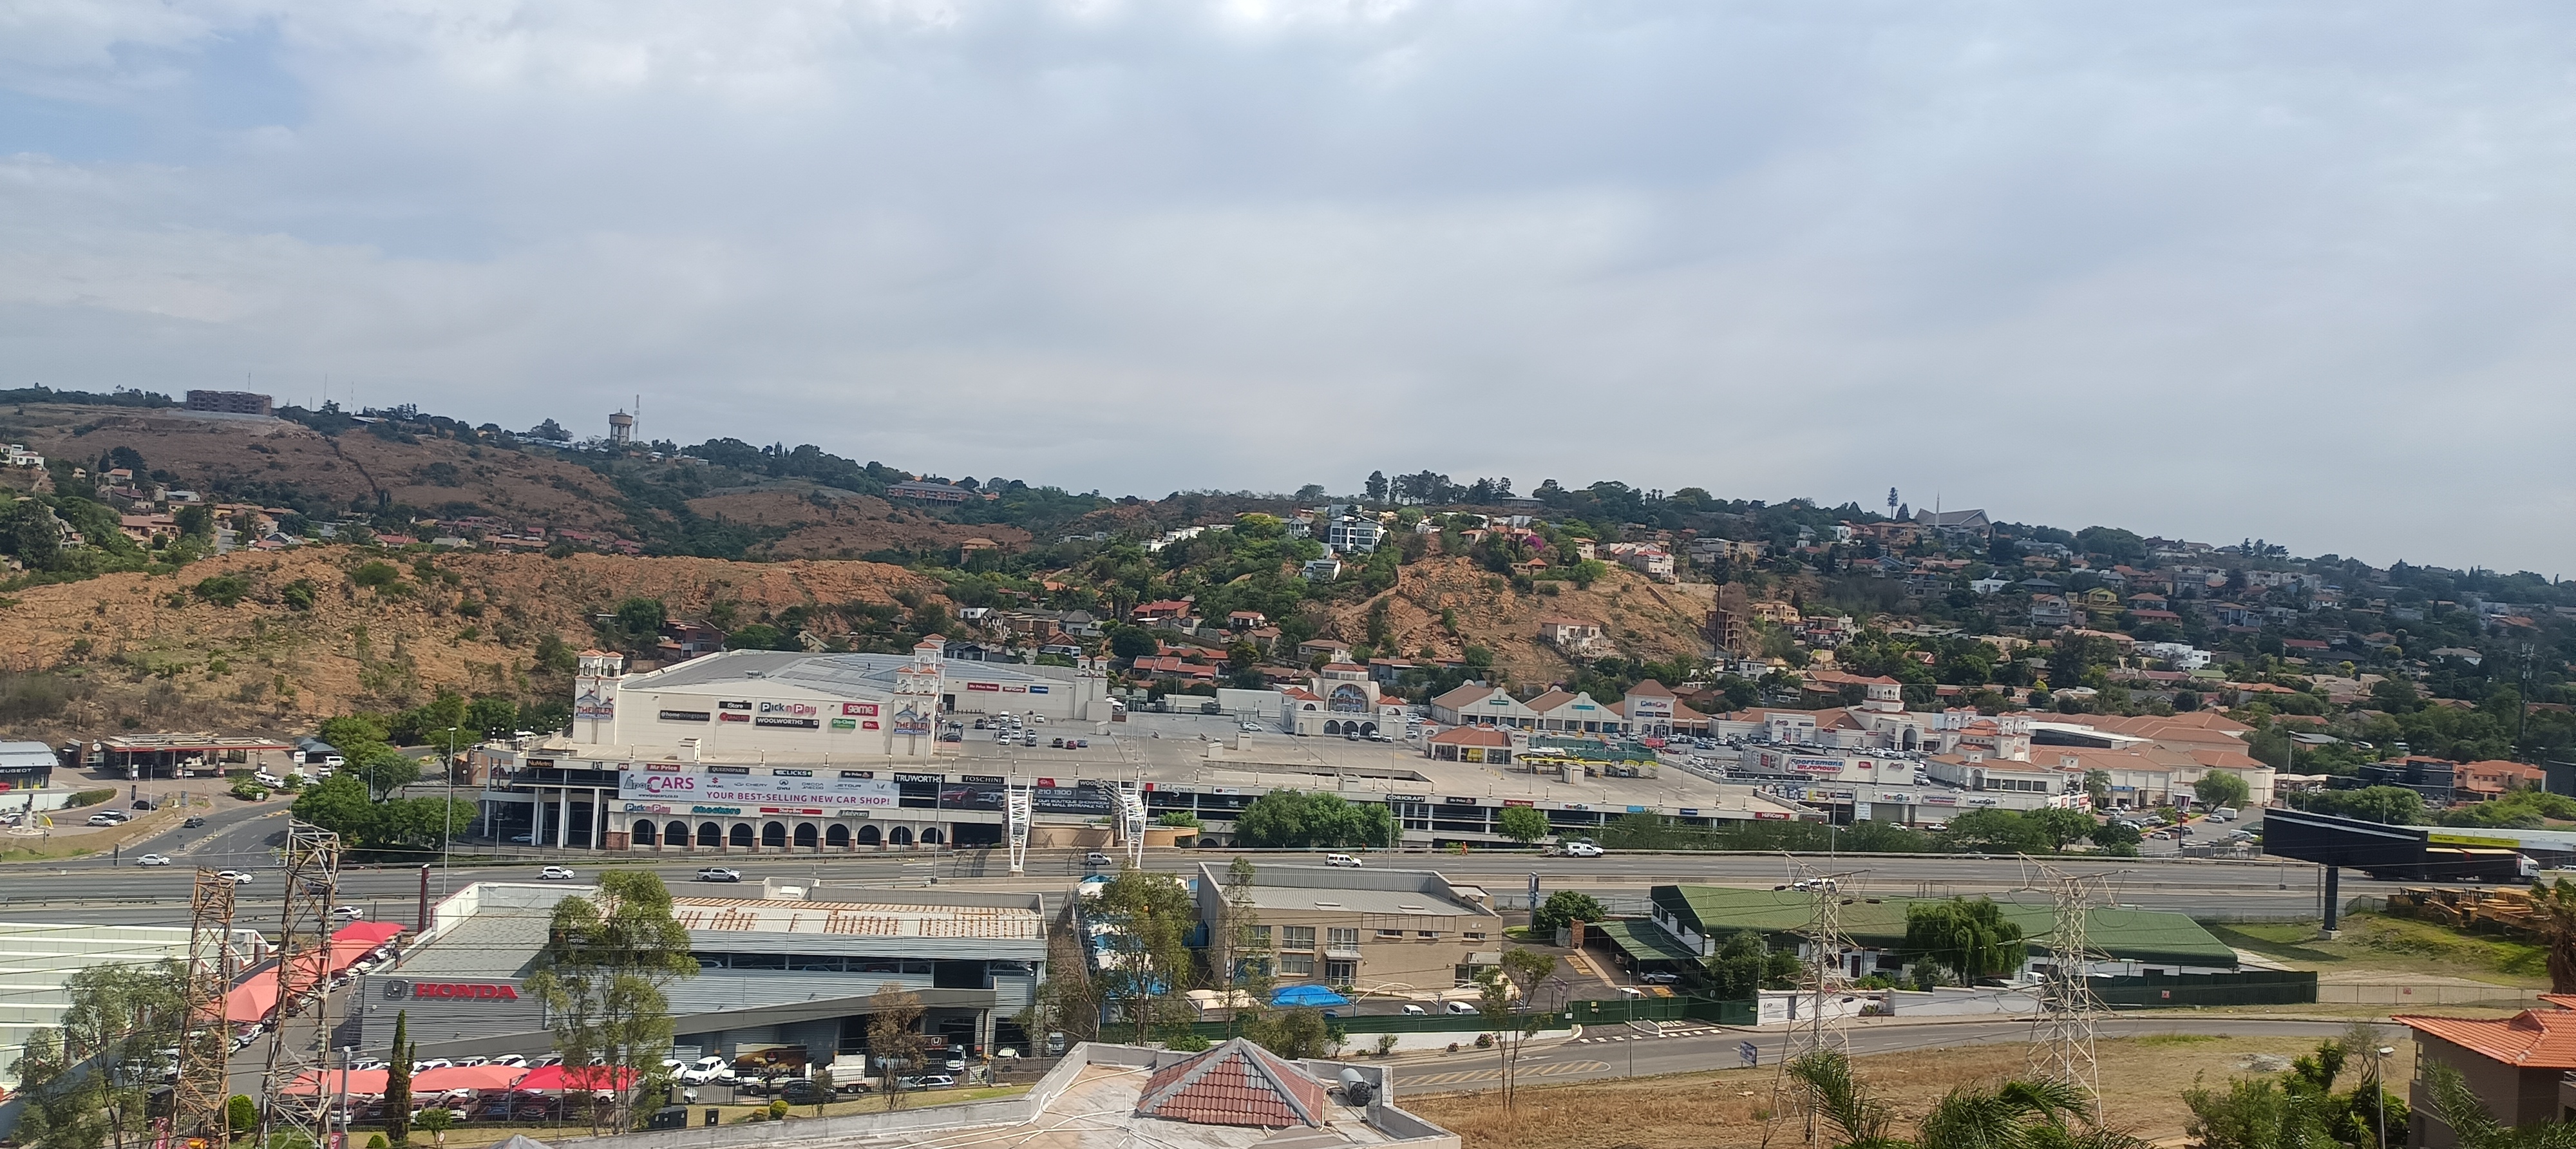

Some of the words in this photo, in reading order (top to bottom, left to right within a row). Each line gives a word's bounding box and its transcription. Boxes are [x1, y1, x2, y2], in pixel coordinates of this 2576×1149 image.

[761, 702, 784, 712] Pick
[794, 704, 817, 714] Pay
[848, 705, 874, 714] game
[1790, 758, 1844, 767] Sportsmans
[896, 774, 942, 783] TRUWORTHS
[737, 793, 807, 802] BEST-SELLING
[860, 797, 890, 805] SHOP!
[692, 806, 741, 815] Checkers
[415, 982, 518, 999] HONDA
